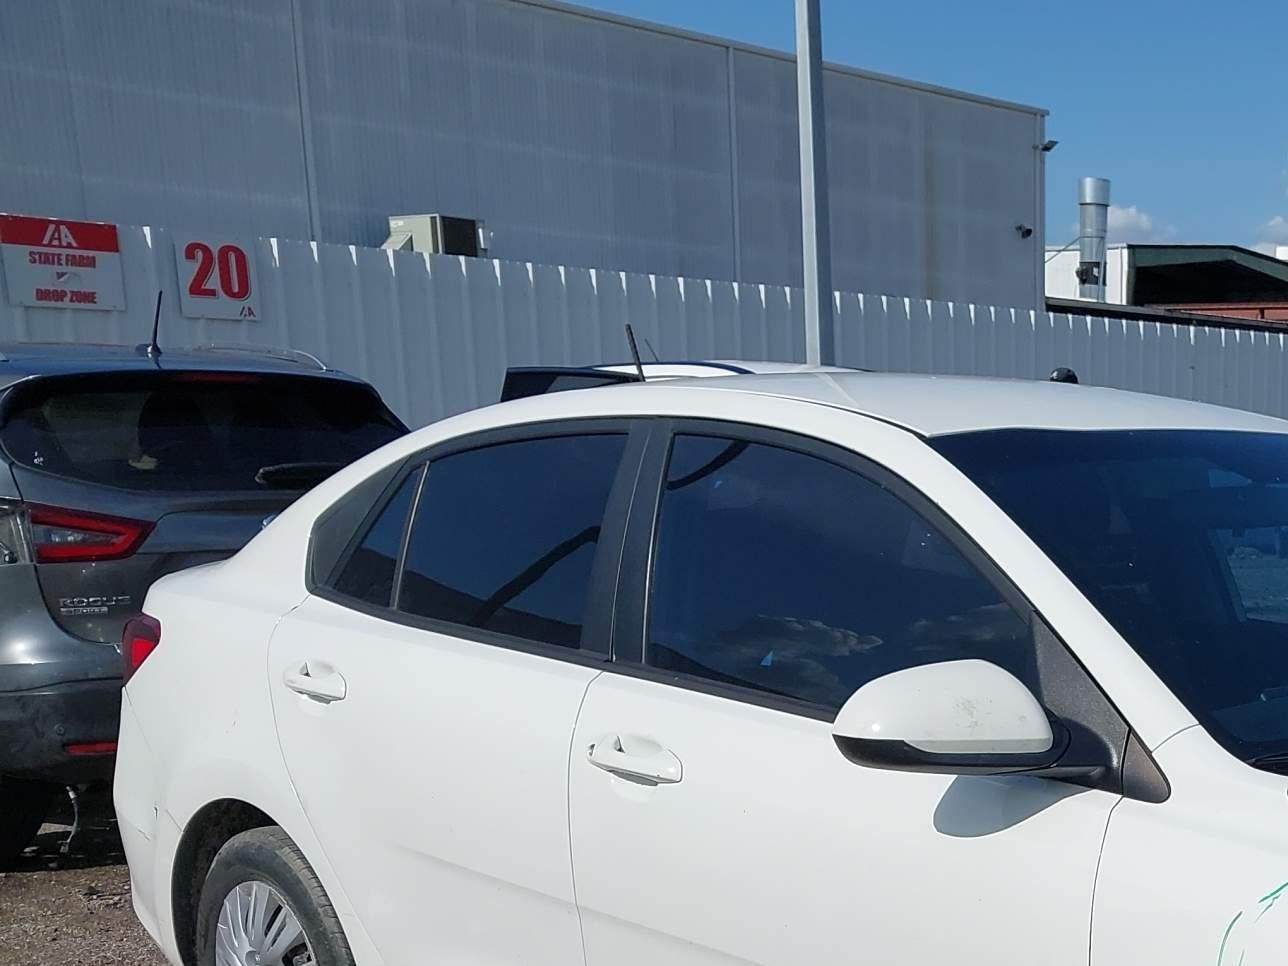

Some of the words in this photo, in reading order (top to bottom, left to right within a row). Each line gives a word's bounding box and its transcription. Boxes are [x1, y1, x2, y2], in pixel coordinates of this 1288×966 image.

[28, 250, 64, 267] STATE
[65, 253, 97, 269] FARM
[185, 242, 251, 300] 20
[36, 288, 67, 302] DROP
[69, 291, 97, 304] ZONE
